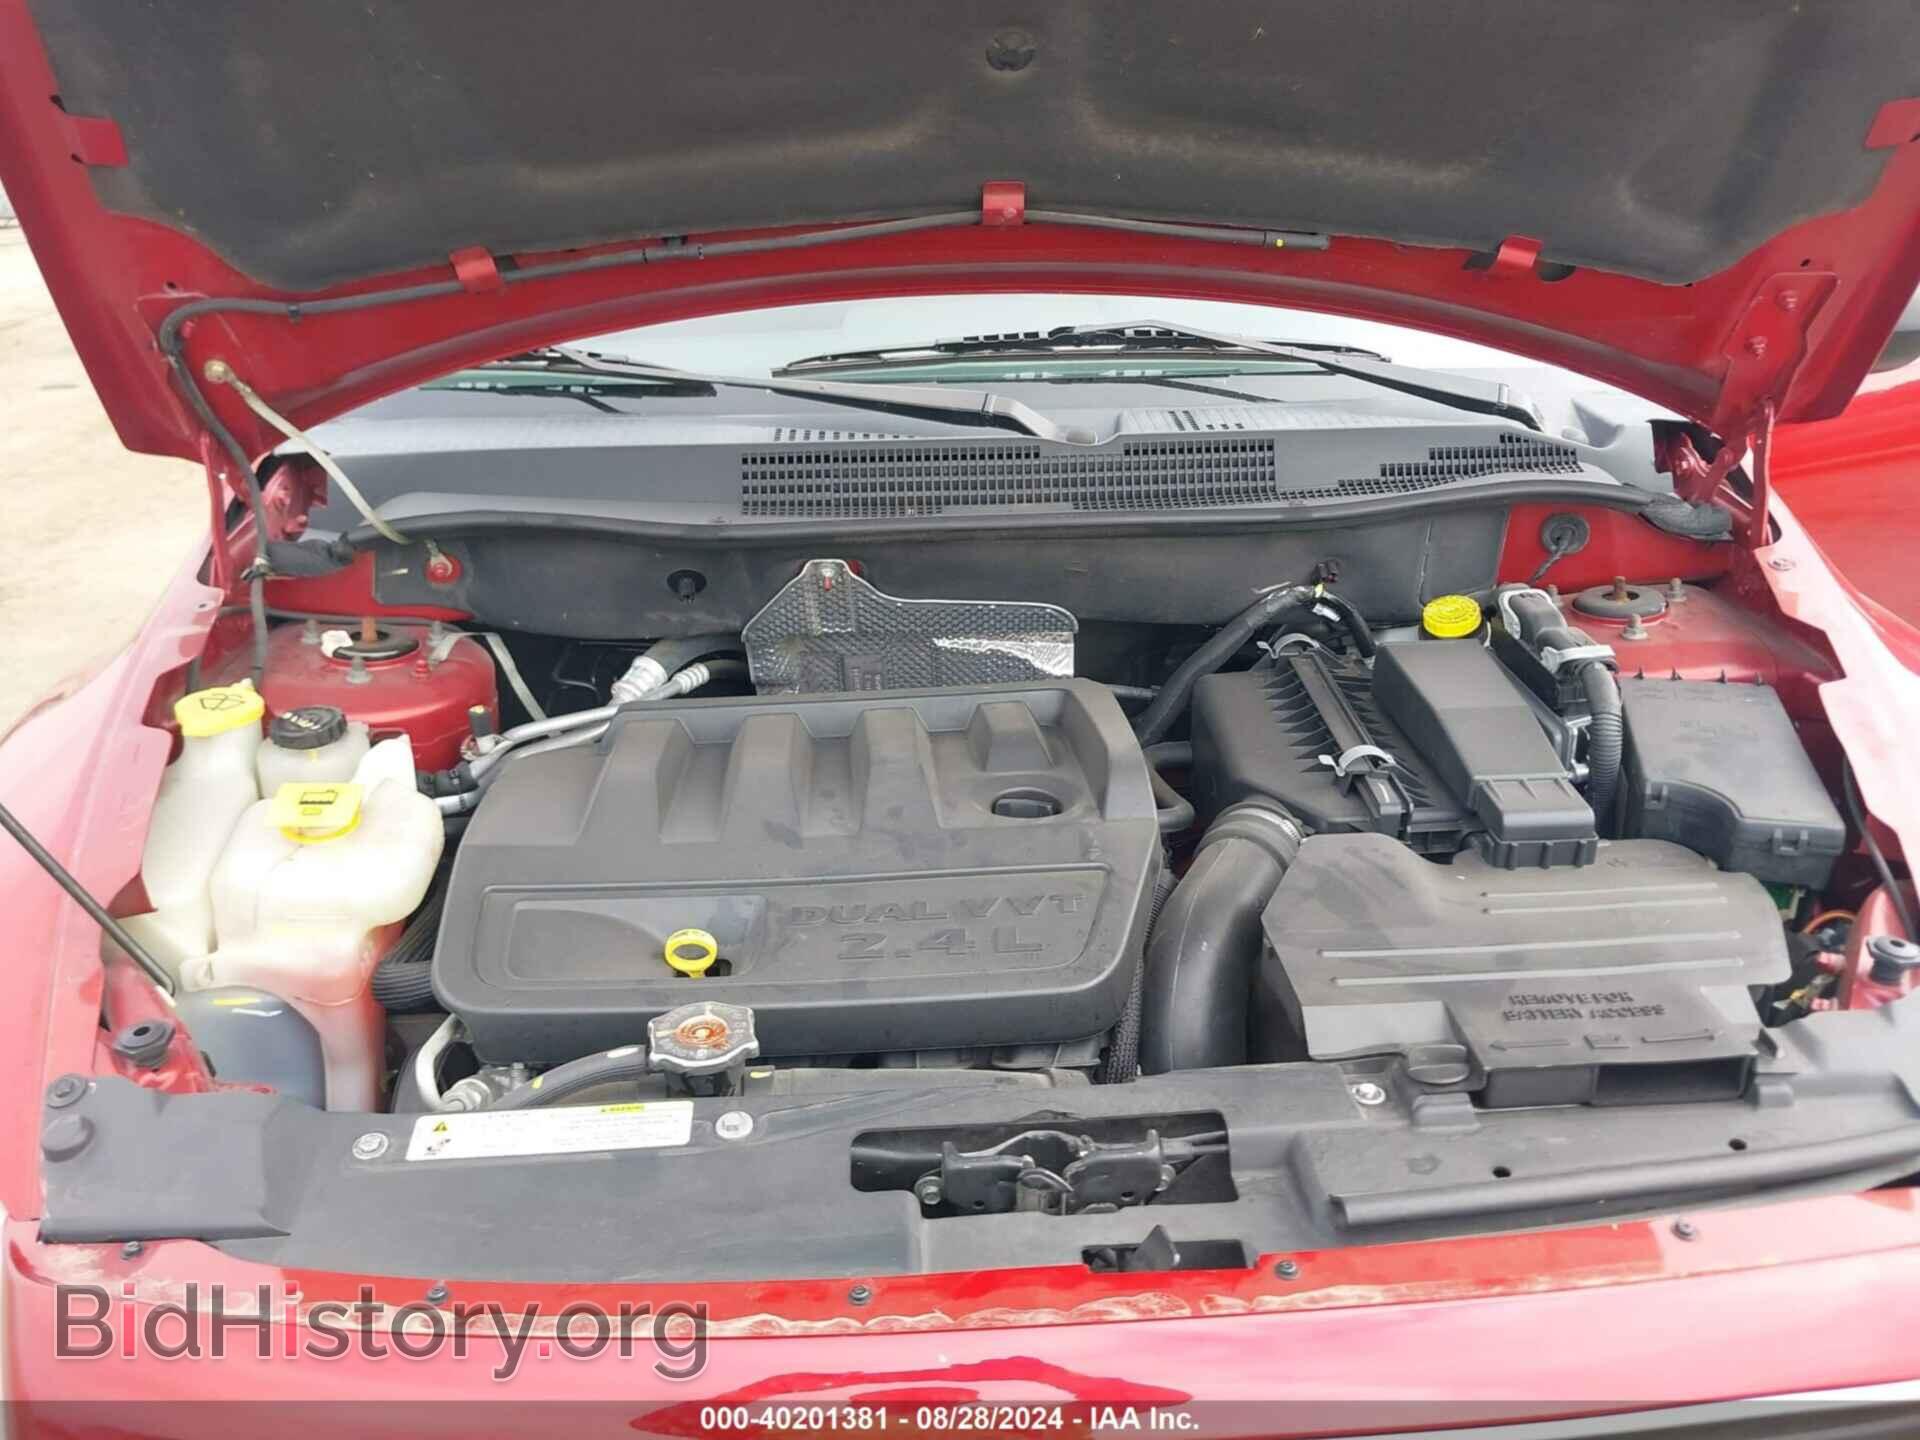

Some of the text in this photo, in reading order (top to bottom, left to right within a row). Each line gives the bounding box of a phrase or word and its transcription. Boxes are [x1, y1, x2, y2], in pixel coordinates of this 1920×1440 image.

[791, 894, 1087, 926] DUAL VVT
[1508, 992, 1592, 1006] REMOVE
